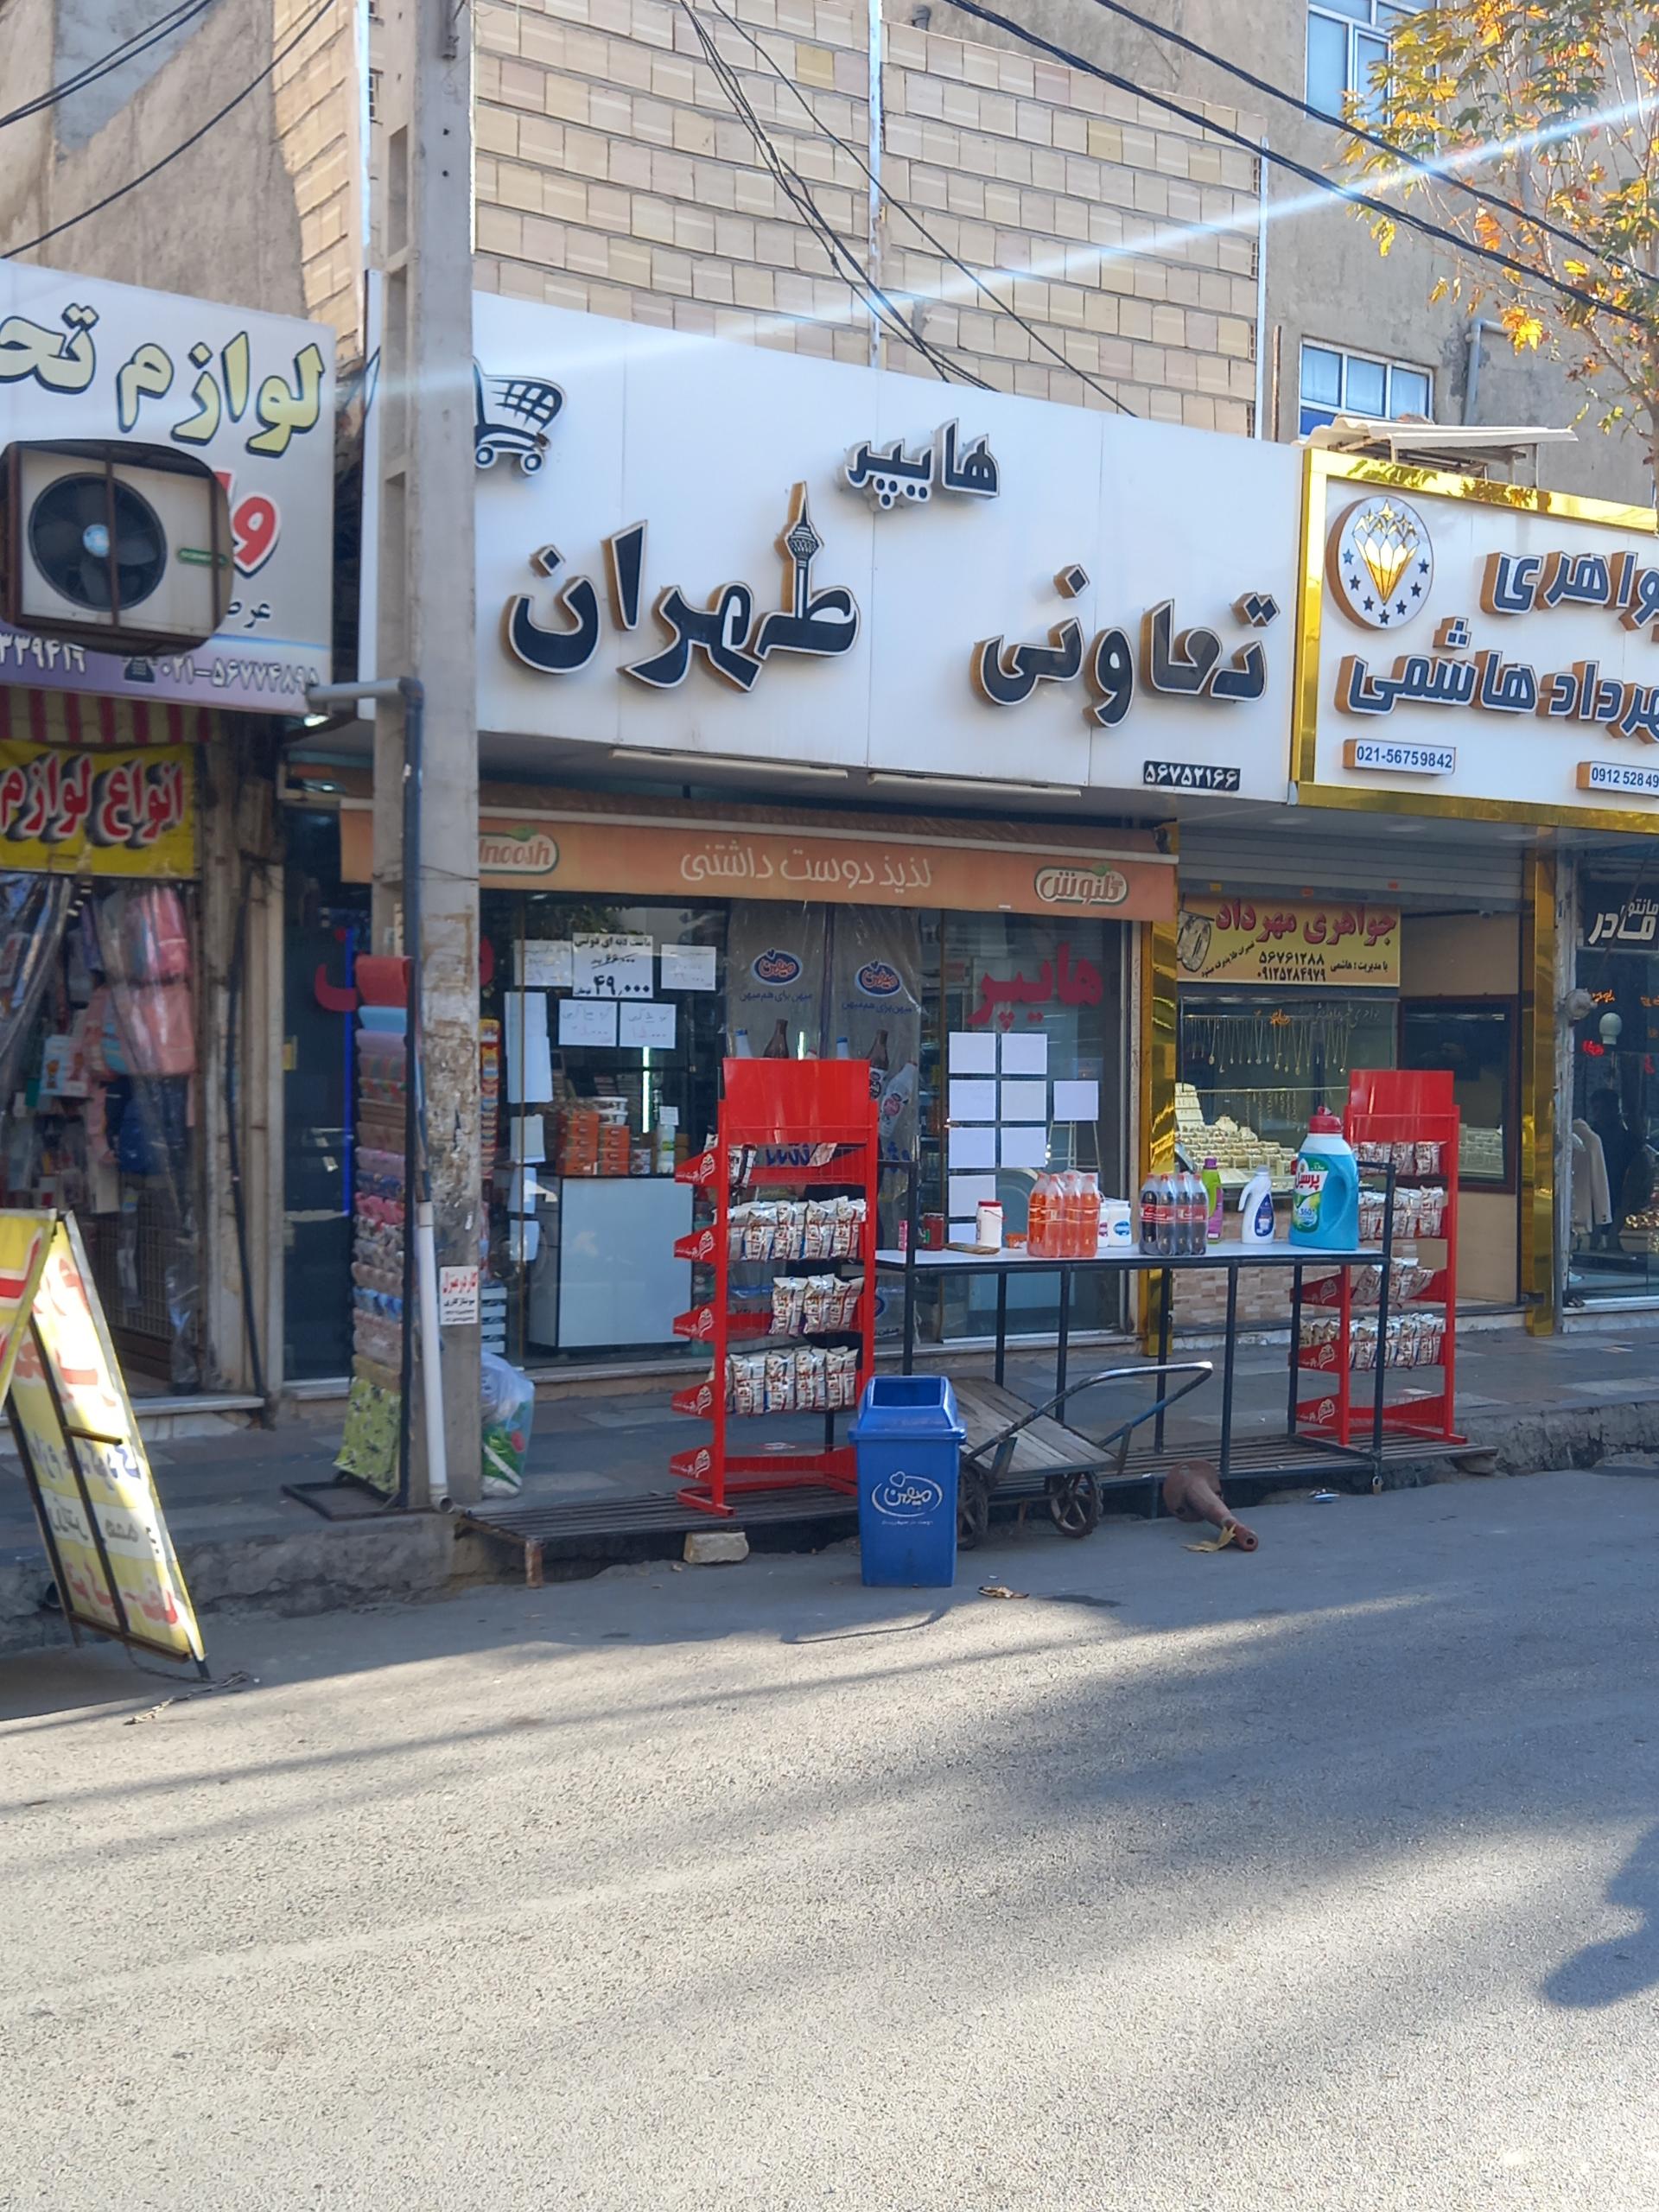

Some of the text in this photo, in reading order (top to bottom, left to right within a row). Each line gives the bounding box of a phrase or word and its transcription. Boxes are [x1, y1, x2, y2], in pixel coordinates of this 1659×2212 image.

[0, 302, 325, 457] لوازم تح
[842, 417, 1000, 511] هایپر
[503, 481, 1281, 728] تعاونی طهران
[1480, 550, 1659, 634] واهری
[1334, 617, 1538, 715] هاشمی
[0, 749, 185, 846] انواع لوازم
[1144, 764, 1238, 790] ۵۶۷۵۲۱۶۶
[1356, 746, 1452, 769] 021-56759842
[1591, 766, 1620, 784] 0912
[1623, 771, 1643, 786] 528
[680, 840, 932, 894] لذیذ دوست داشتنی
[1039, 870, 1124, 905] گلنوش
[1215, 898, 1396, 946] جواهری مهرداد
[967, 942, 1104, 1030] هایپر
